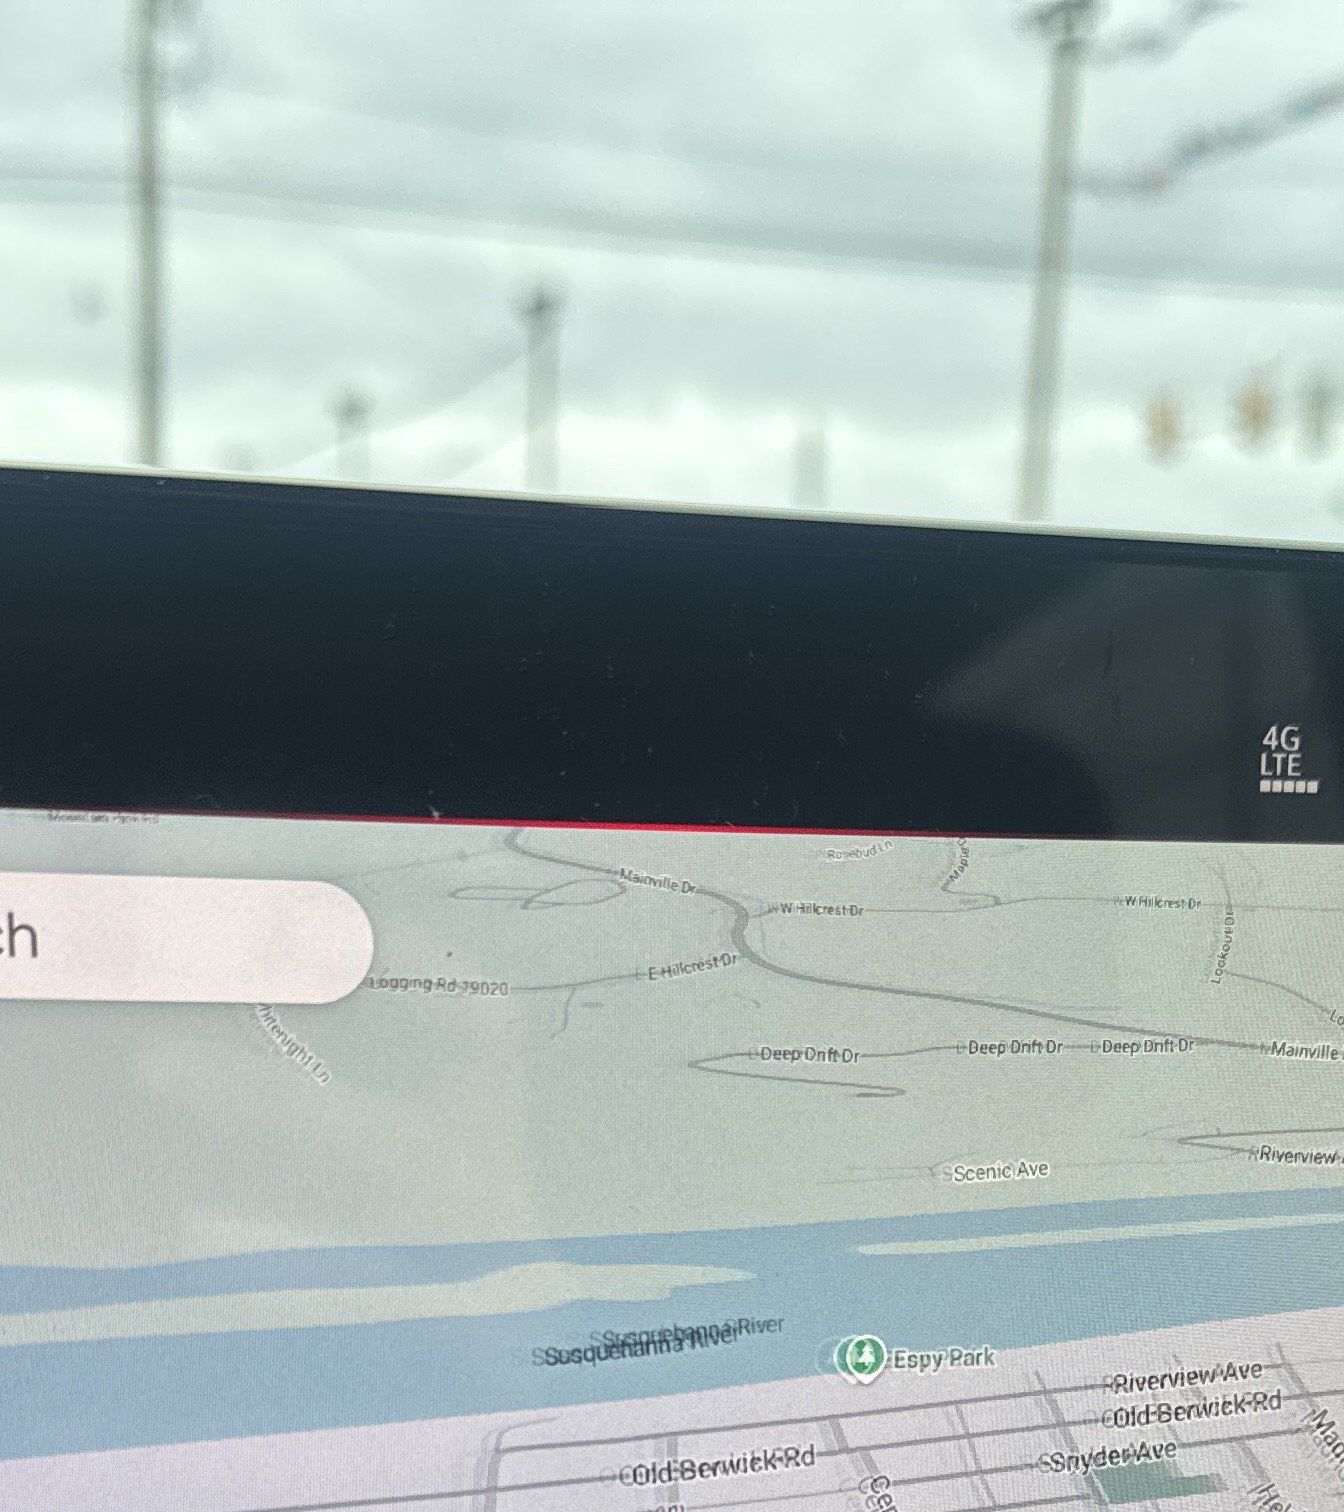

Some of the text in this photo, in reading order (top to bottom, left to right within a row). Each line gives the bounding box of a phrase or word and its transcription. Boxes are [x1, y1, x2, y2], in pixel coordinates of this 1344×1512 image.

[1261, 726, 1301, 751] 4G
[1260, 753, 1301, 778] LTE
[681, 880, 696, 894] Dr
[781, 902, 864, 917] W Hillcrest Dr
[1125, 895, 1201, 910] W Hillcrest Dr
[1210, 911, 1235, 985] Lookout Dr
[648, 953, 738, 981] E Hillcrest Dr
[370, 976, 433, 993] Logging
[436, 977, 456, 993] Rd
[760, 1046, 860, 1064] Deep Drift Dr
[968, 1038, 1064, 1057] Deep Drift Dr
[1102, 1037, 1195, 1057] Deep Drift Dr
[1271, 1040, 1340, 1060] Mainville
[1259, 1145, 1339, 1165] Riverview
[953, 1161, 1049, 1183] Scenic Ave
[737, 1317, 785, 1336] River
[893, 1347, 996, 1373] Espy Park
[1111, 1361, 1263, 1395] Riverview Ave
[1110, 1388, 1282, 1430] Old Berwick Rd
[628, 1443, 816, 1486] Old Berwick Rd
[1045, 1441, 1178, 1475] Snyder Ave
